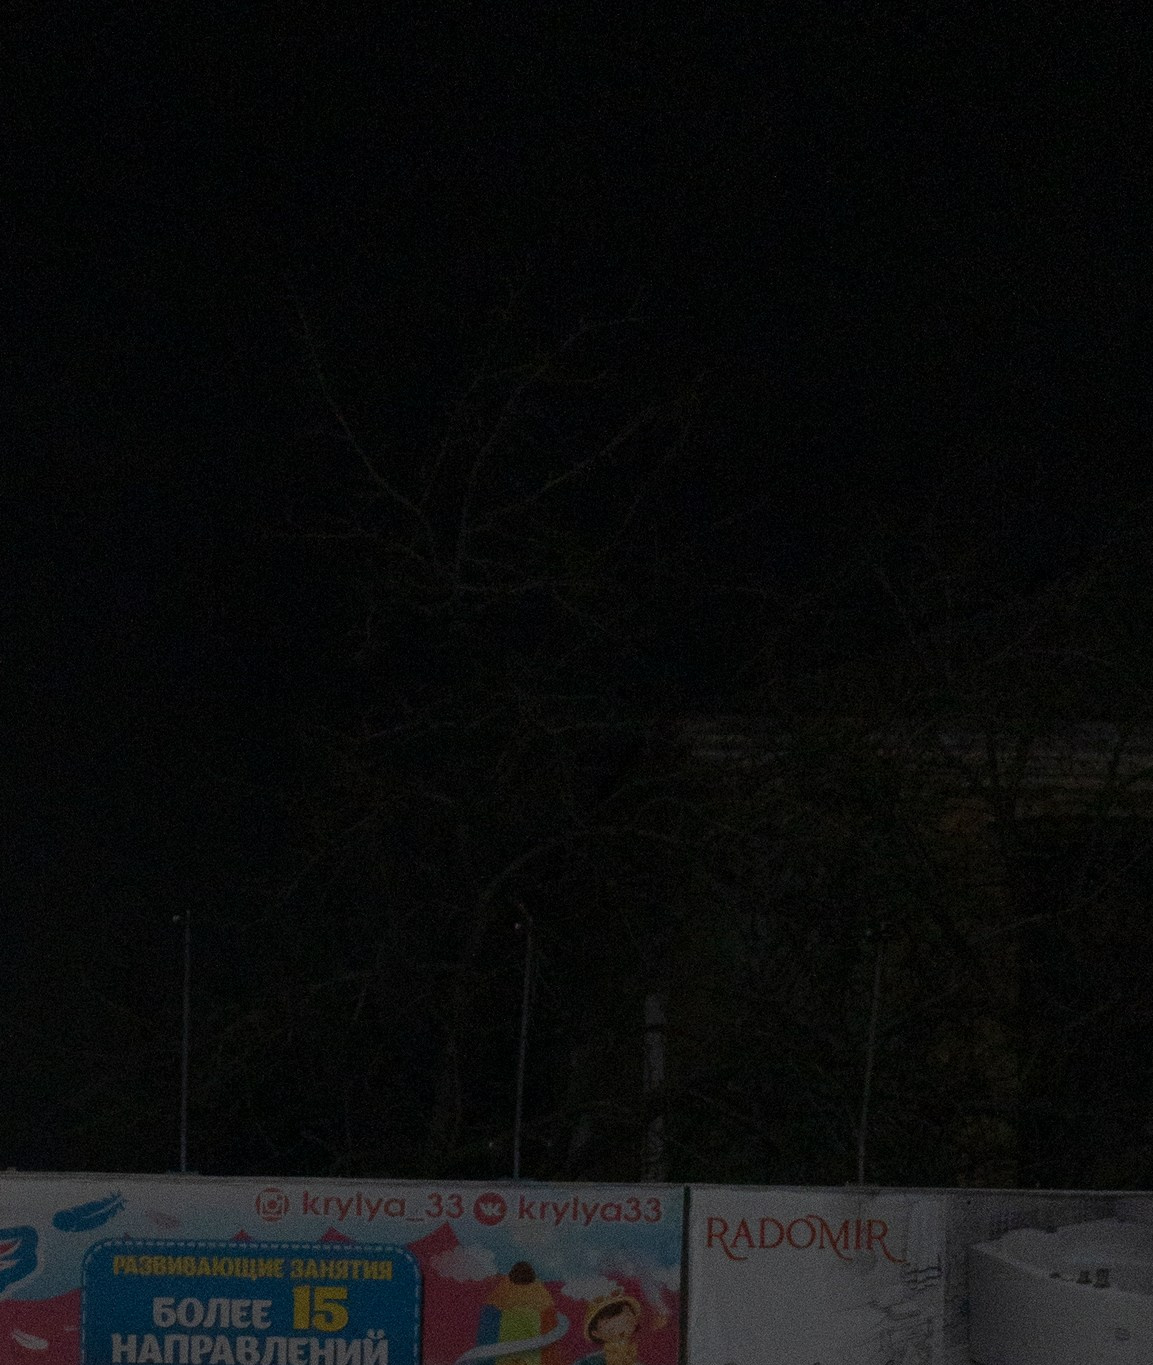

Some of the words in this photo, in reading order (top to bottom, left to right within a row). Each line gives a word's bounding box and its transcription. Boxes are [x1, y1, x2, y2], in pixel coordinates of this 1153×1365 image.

[302, 1190, 465, 1223] krylya_33
[517, 1195, 664, 1227] krylya33
[706, 1213, 911, 1265] RADOMIR
[112, 1255, 285, 1280] РАЗВИВАЮЩИЕ
[290, 1258, 394, 1281] ЗАНЯТИЯ
[152, 1296, 273, 1330] БОЛЕЕ
[292, 1284, 350, 1333] 15
